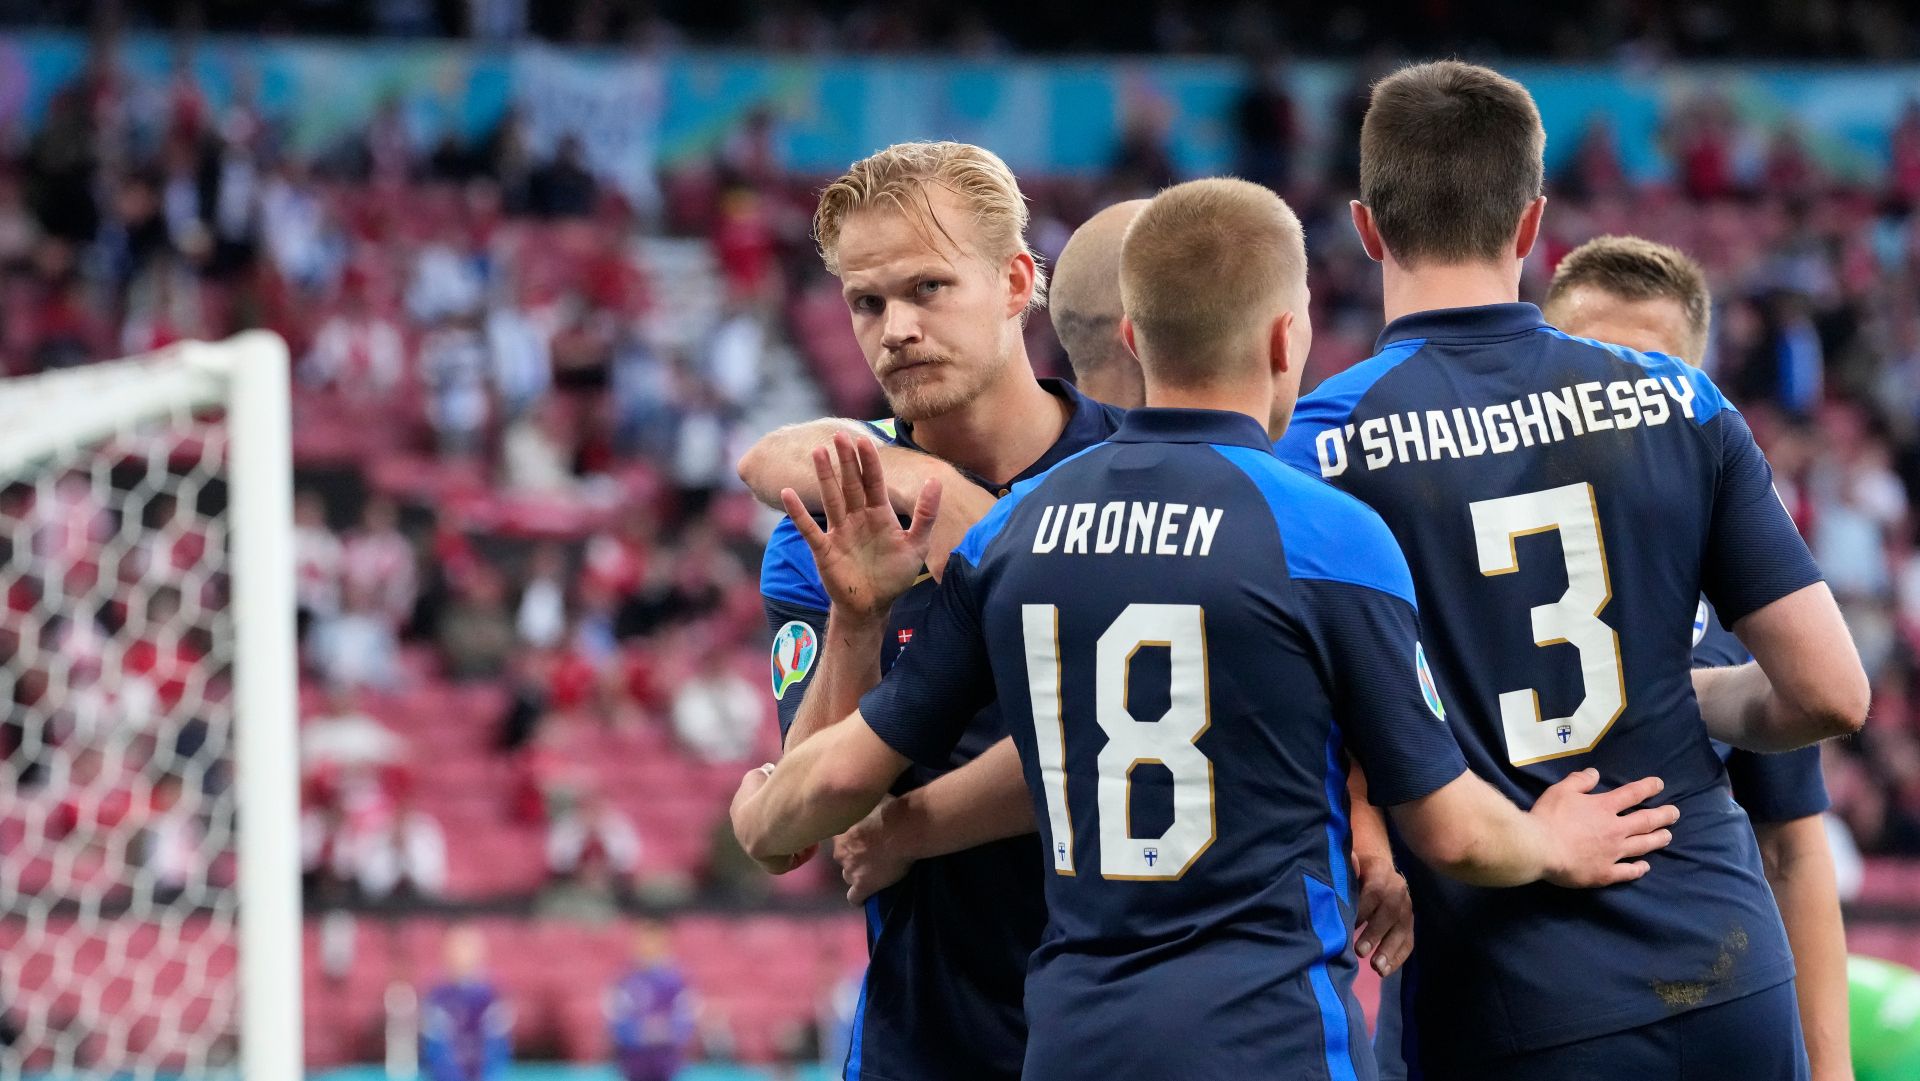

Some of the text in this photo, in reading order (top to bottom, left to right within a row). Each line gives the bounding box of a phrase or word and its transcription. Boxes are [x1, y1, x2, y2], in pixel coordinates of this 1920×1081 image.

[1315, 375, 1696, 478] O'SHAUGHNESSY
[1031, 501, 1224, 556] URONEN
[1468, 481, 1627, 767] 3
[1021, 603, 1217, 881] 18
